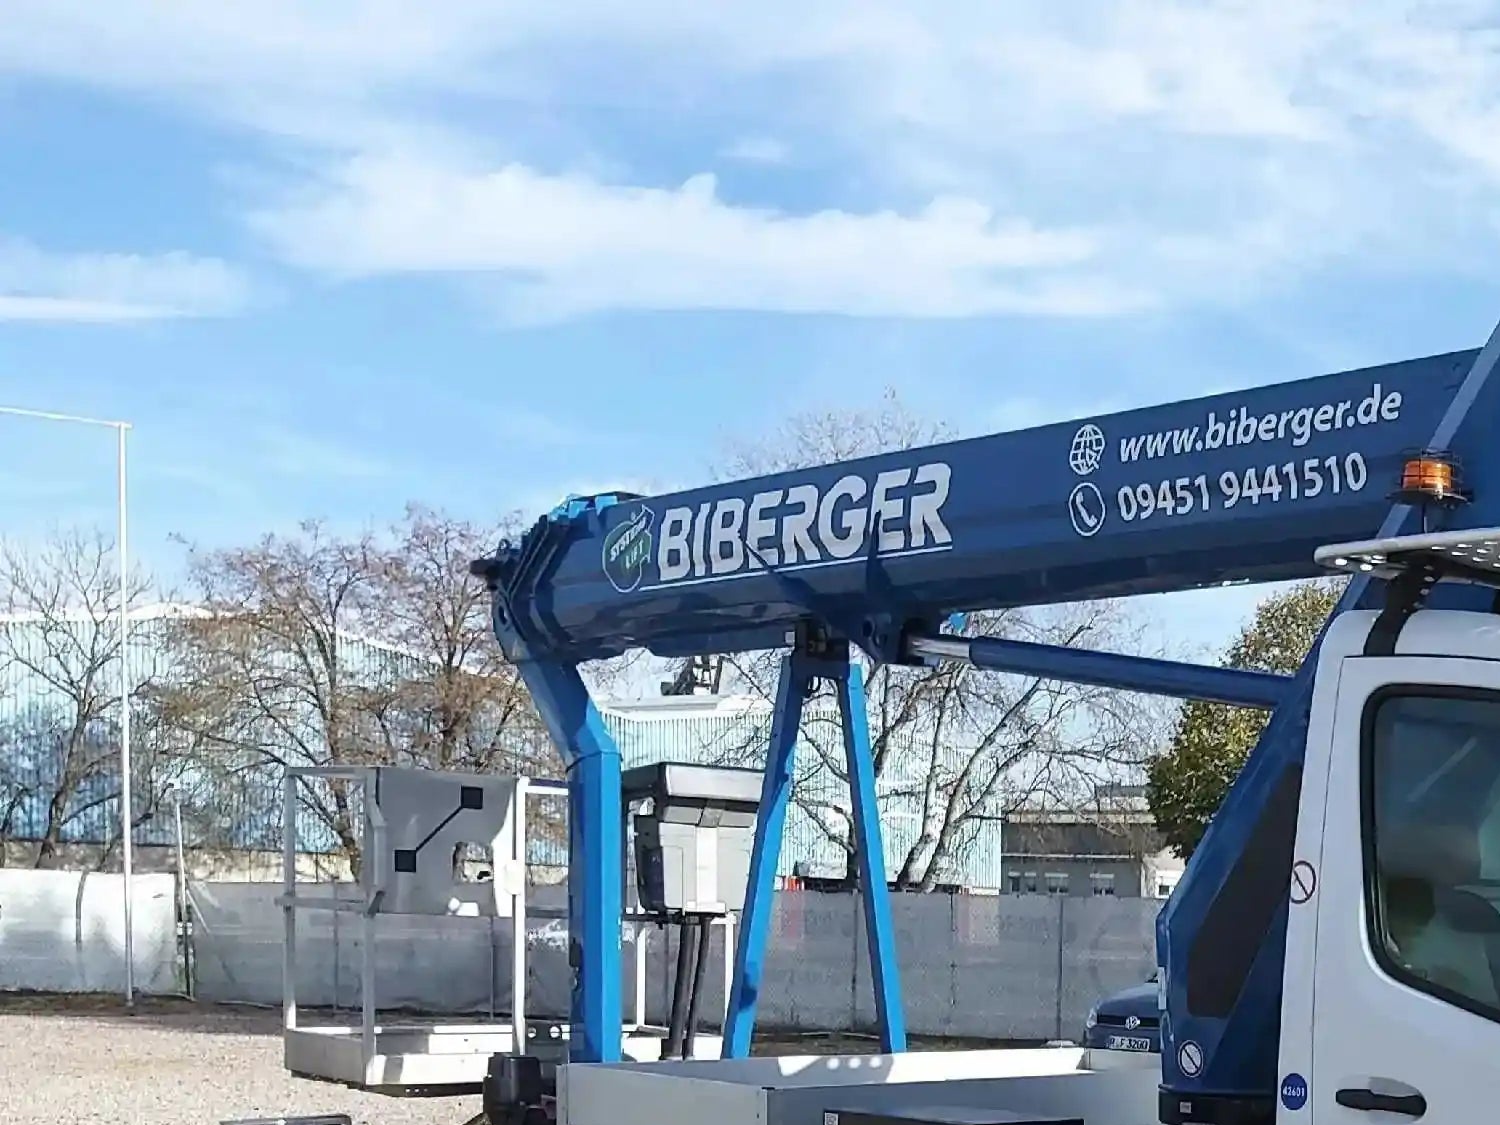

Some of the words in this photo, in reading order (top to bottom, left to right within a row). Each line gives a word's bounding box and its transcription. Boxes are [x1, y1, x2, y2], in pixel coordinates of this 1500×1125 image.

[1119, 383, 1402, 463] www.biberger.de
[657, 462, 952, 582] BIBERGER
[1117, 474, 1210, 522] 09451
[1219, 452, 1367, 509] 9441510
[1283, 1085, 1305, 1097] 42601
